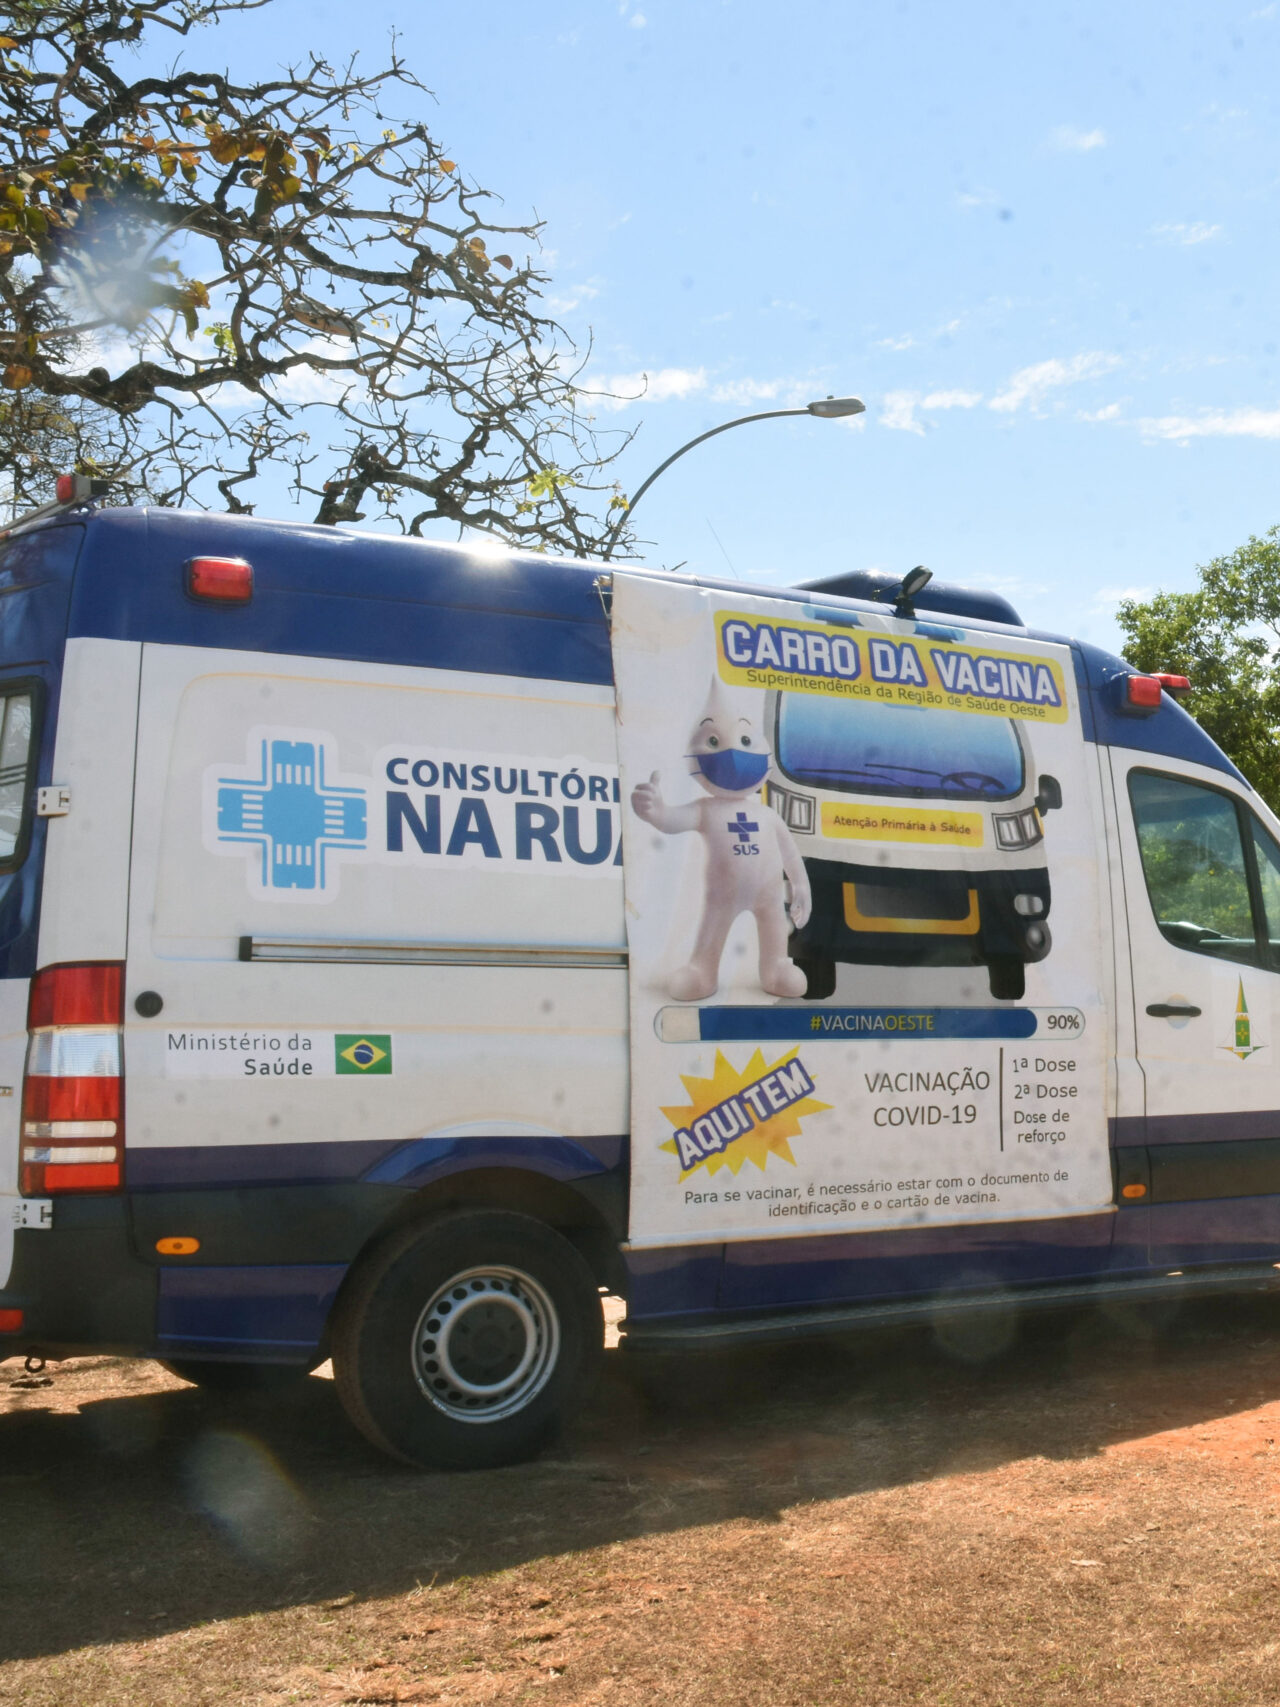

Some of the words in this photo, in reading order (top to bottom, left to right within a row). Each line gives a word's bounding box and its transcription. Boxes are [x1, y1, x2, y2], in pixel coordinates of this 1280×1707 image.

[724, 622, 858, 678] CARRO
[870, 640, 925, 685] DA
[932, 651, 1059, 704] VACINA
[747, 670, 871, 696] Superintendência
[876, 686, 892, 698] da
[898, 687, 942, 704] Região
[947, 695, 962, 707] de
[967, 697, 1006, 712] Saúde
[1010, 703, 1046, 717] Oeste
[386, 790, 503, 859] NA
[515, 801, 624, 867] RU
[833, 816, 878, 829] Atenção
[882, 818, 926, 831] Primária
[930, 821, 936, 832] à
[941, 822, 971, 834] Saúde
[733, 844, 760, 856] SUS
[810, 1015, 934, 1031] #VACINAOESTE
[1047, 1015, 1080, 1030] 90%
[168, 1032, 281, 1050] Ministério
[288, 1033, 312, 1050] da
[244, 1057, 313, 1075] Saúde
[1035, 1058, 1076, 1072] Dose
[865, 1067, 990, 1095] VACINAÇÃO
[1036, 1084, 1078, 1098] Dose
[676, 1098, 751, 1168] AQUI
[742, 1060, 812, 1119] TEM
[874, 1104, 977, 1126] COVID-19
[1014, 1110, 1047, 1124] Dose
[1052, 1109, 1070, 1122] de
[1018, 1129, 1066, 1144] reforço
[685, 1191, 718, 1204] Para
[724, 1191, 741, 1202] se
[746, 1186, 801, 1200] vacinar,
[807, 1183, 815, 1196] é
[820, 1180, 892, 1196] necessário
[897, 1179, 931, 1191] estar
[936, 1177, 963, 1189] com
[967, 1177, 975, 1187] o
[981, 1171, 1050, 1186] documento
[1053, 1169, 1069, 1182] de
[769, 1199, 856, 1217] identificação
[861, 1200, 869, 1210] e
[874, 1200, 882, 1210] o
[887, 1194, 929, 1209] cartão
[934, 1193, 950, 1206] de
[955, 1191, 1000, 1204] vacina.
